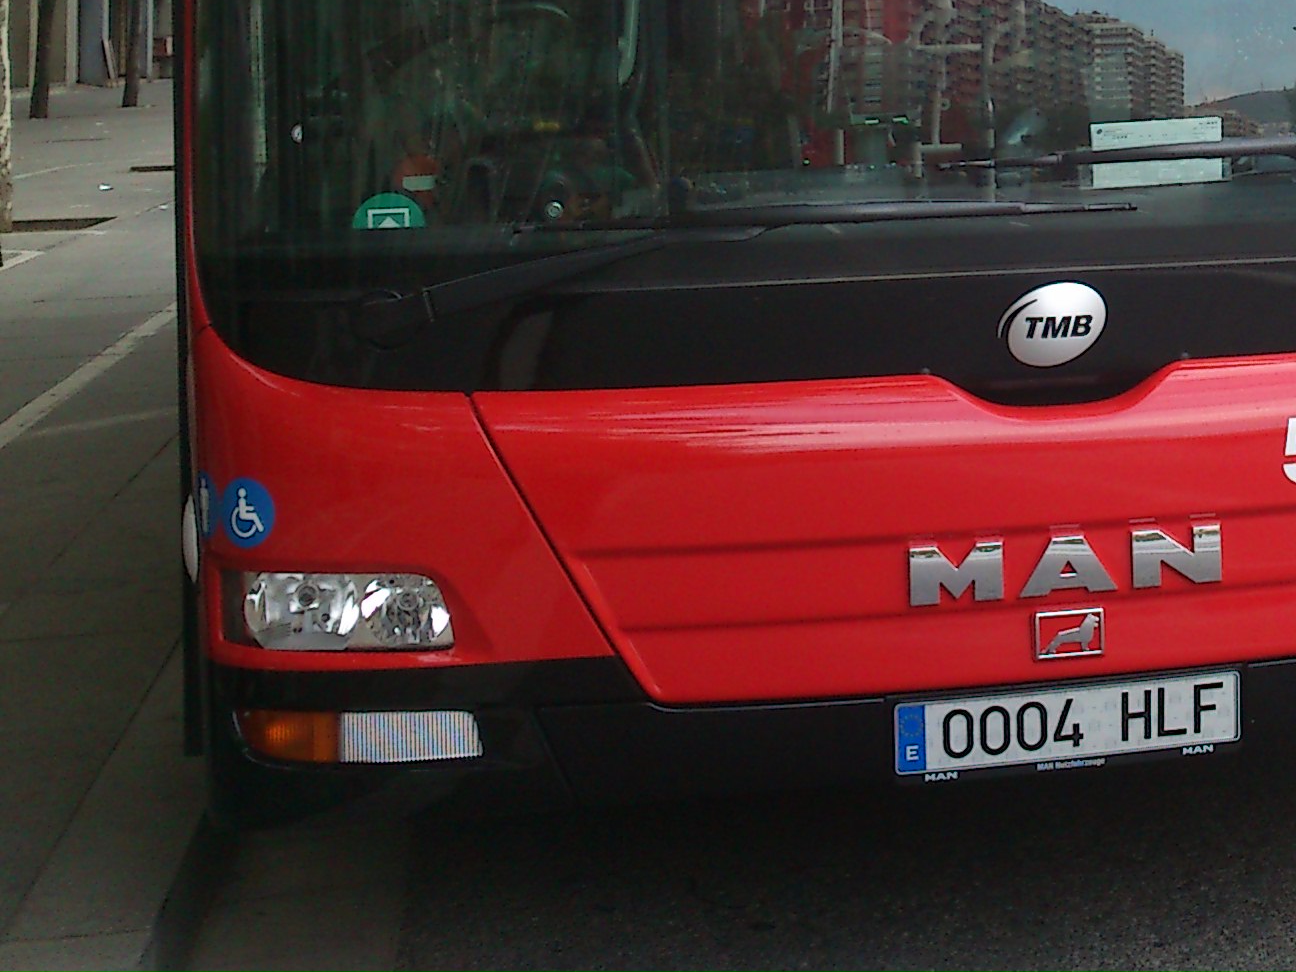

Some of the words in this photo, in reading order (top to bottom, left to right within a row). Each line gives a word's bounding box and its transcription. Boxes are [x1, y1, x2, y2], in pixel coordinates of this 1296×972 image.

[1025, 314, 1094, 341] TMB
[909, 522, 1223, 608] MAN
[941, 697, 1084, 760] 0004
[1120, 681, 1224, 743] HLF
[905, 744, 920, 762] E
[1181, 743, 1215, 756] MAN
[924, 771, 959, 782] MAN
